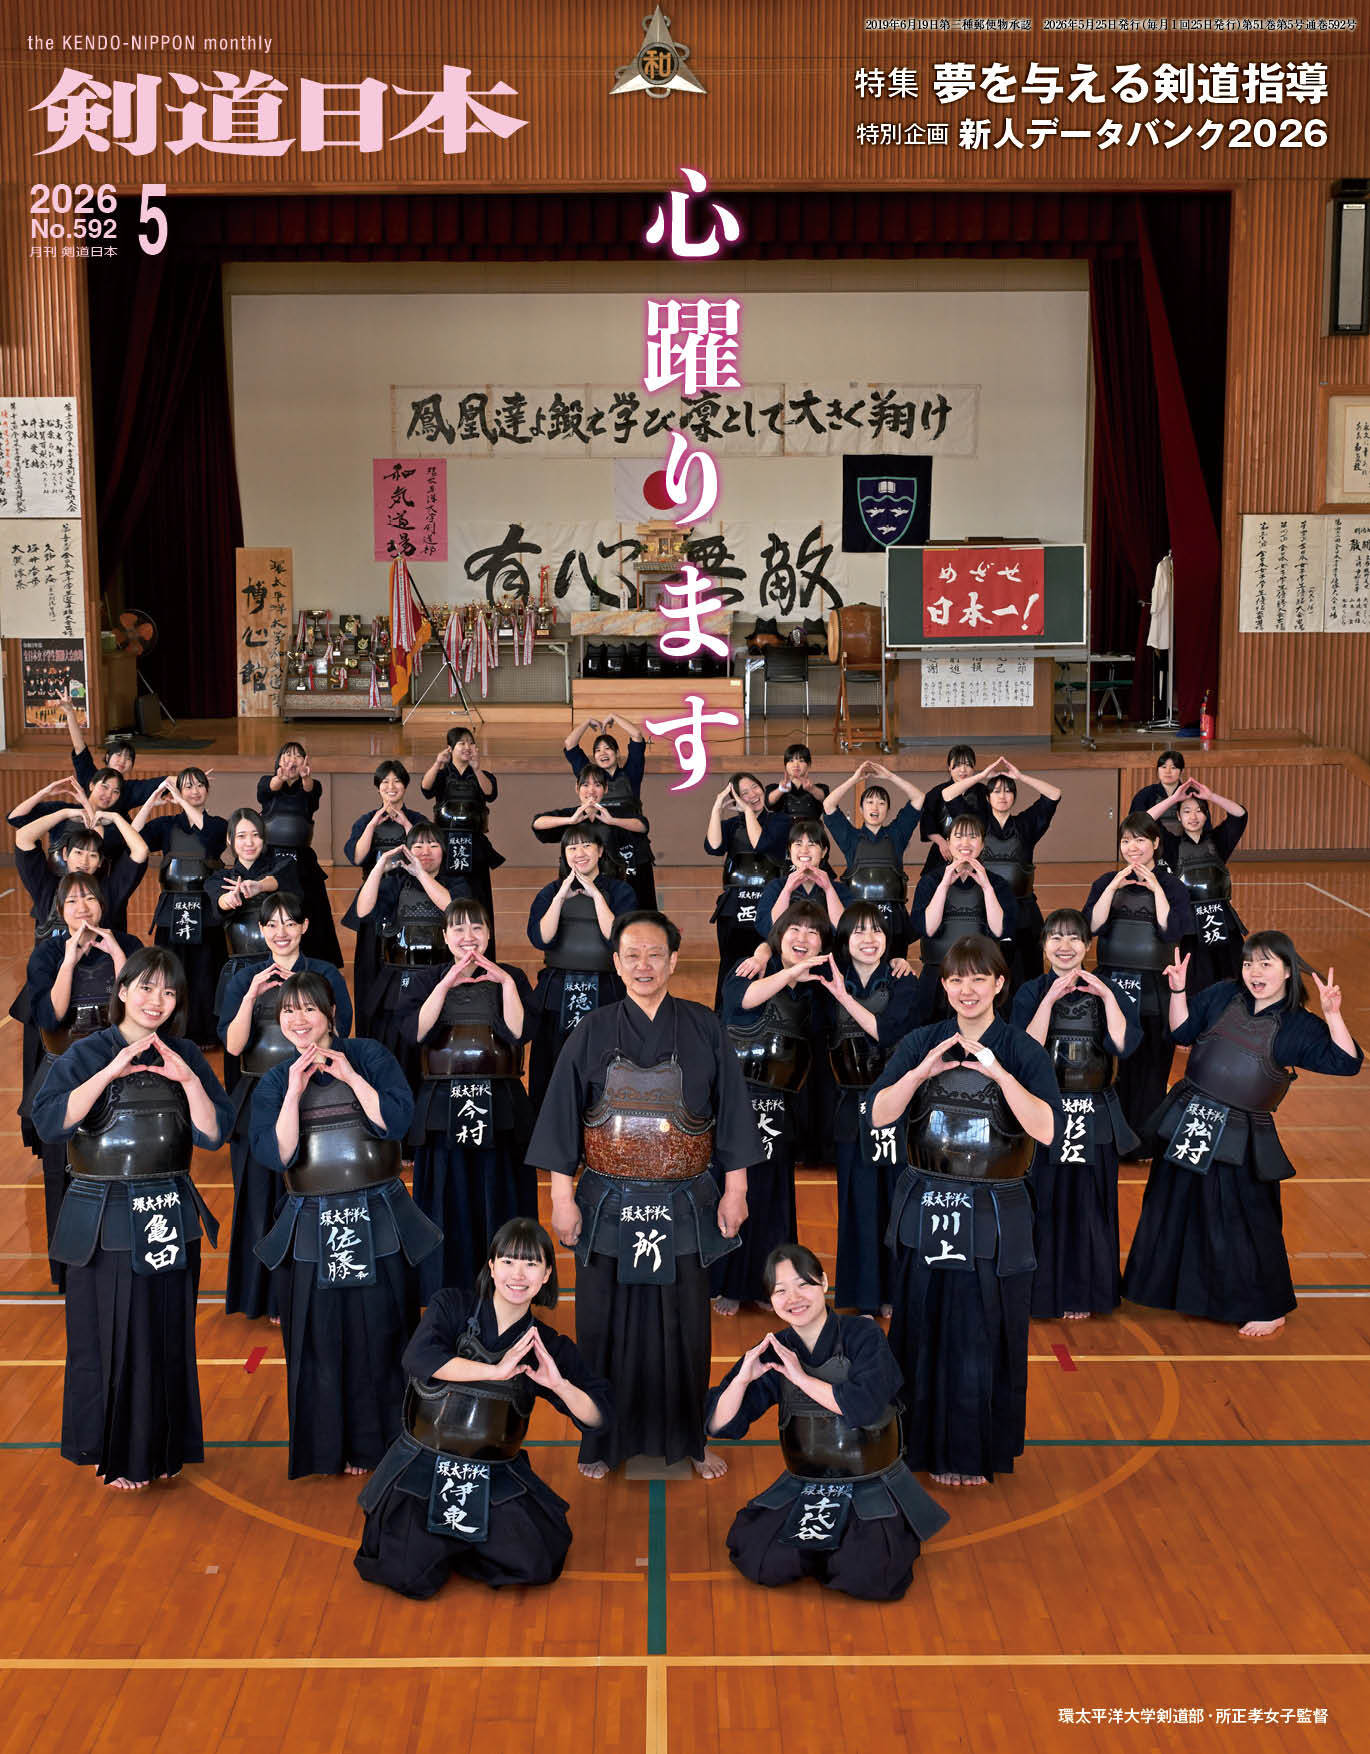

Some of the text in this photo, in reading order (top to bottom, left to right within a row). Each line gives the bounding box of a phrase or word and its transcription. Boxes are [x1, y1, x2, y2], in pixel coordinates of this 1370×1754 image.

[643, 50, 672, 80] 和
[383, 463, 417, 559] 和気道場
[938, 561, 1023, 584] めざせ
[736, 905, 758, 922] 西
[1202, 914, 1228, 945] 久坂
[455, 1099, 489, 1146] 今村
[1059, 1114, 1088, 1164] 杉江
[1170, 1116, 1220, 1165] 松村
[143, 1214, 180, 1271] 亀田
[325, 1226, 368, 1282] 佐藤
[631, 1228, 668, 1273] 所
[923, 1210, 967, 1265] 川上
[436, 1477, 481, 1534] 伊東
